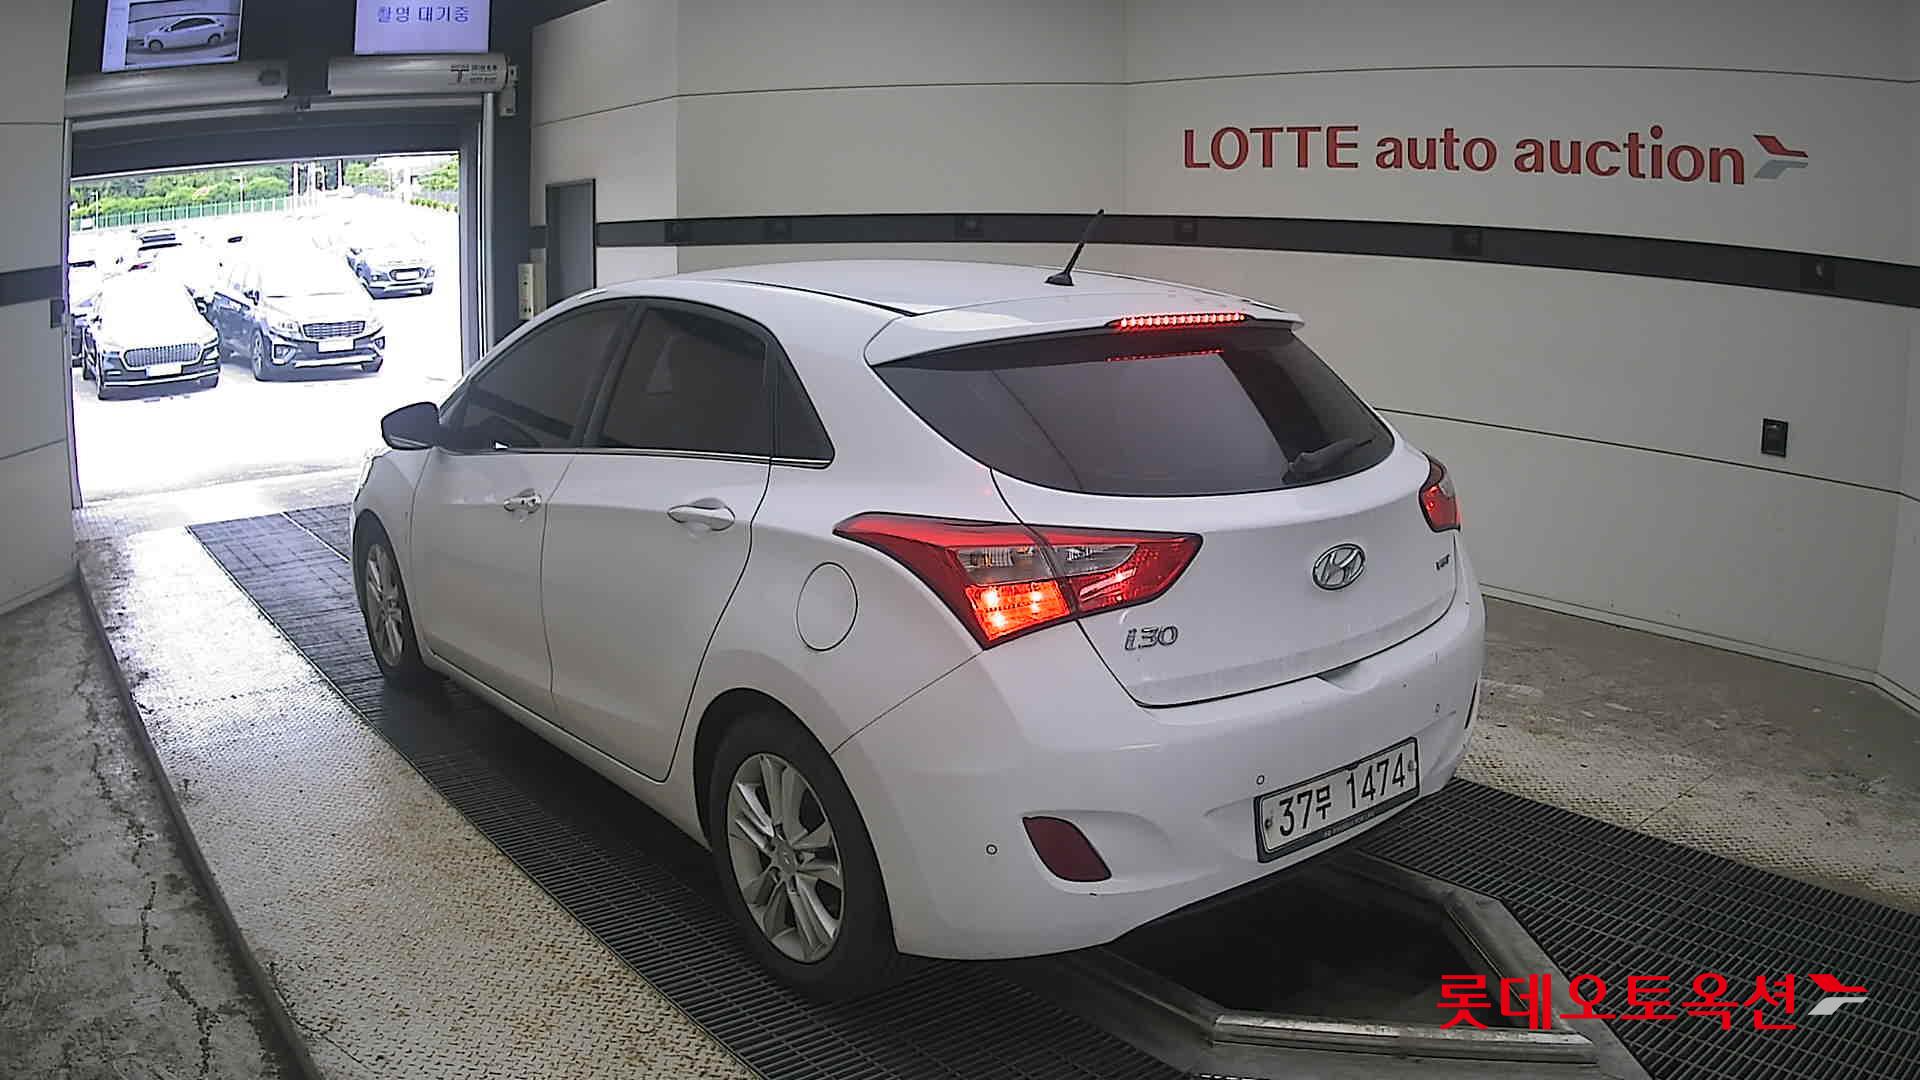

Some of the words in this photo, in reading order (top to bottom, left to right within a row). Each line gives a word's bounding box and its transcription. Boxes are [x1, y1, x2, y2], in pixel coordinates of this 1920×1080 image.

[418, 6, 469, 23] 대기중
[1184, 125, 1359, 170] LOTTE
[1375, 127, 1498, 172] auto
[1513, 124, 1745, 185] auction
[1124, 626, 1178, 651] i30
[1279, 784, 1332, 837] 37무
[1346, 752, 1406, 809] 1474
